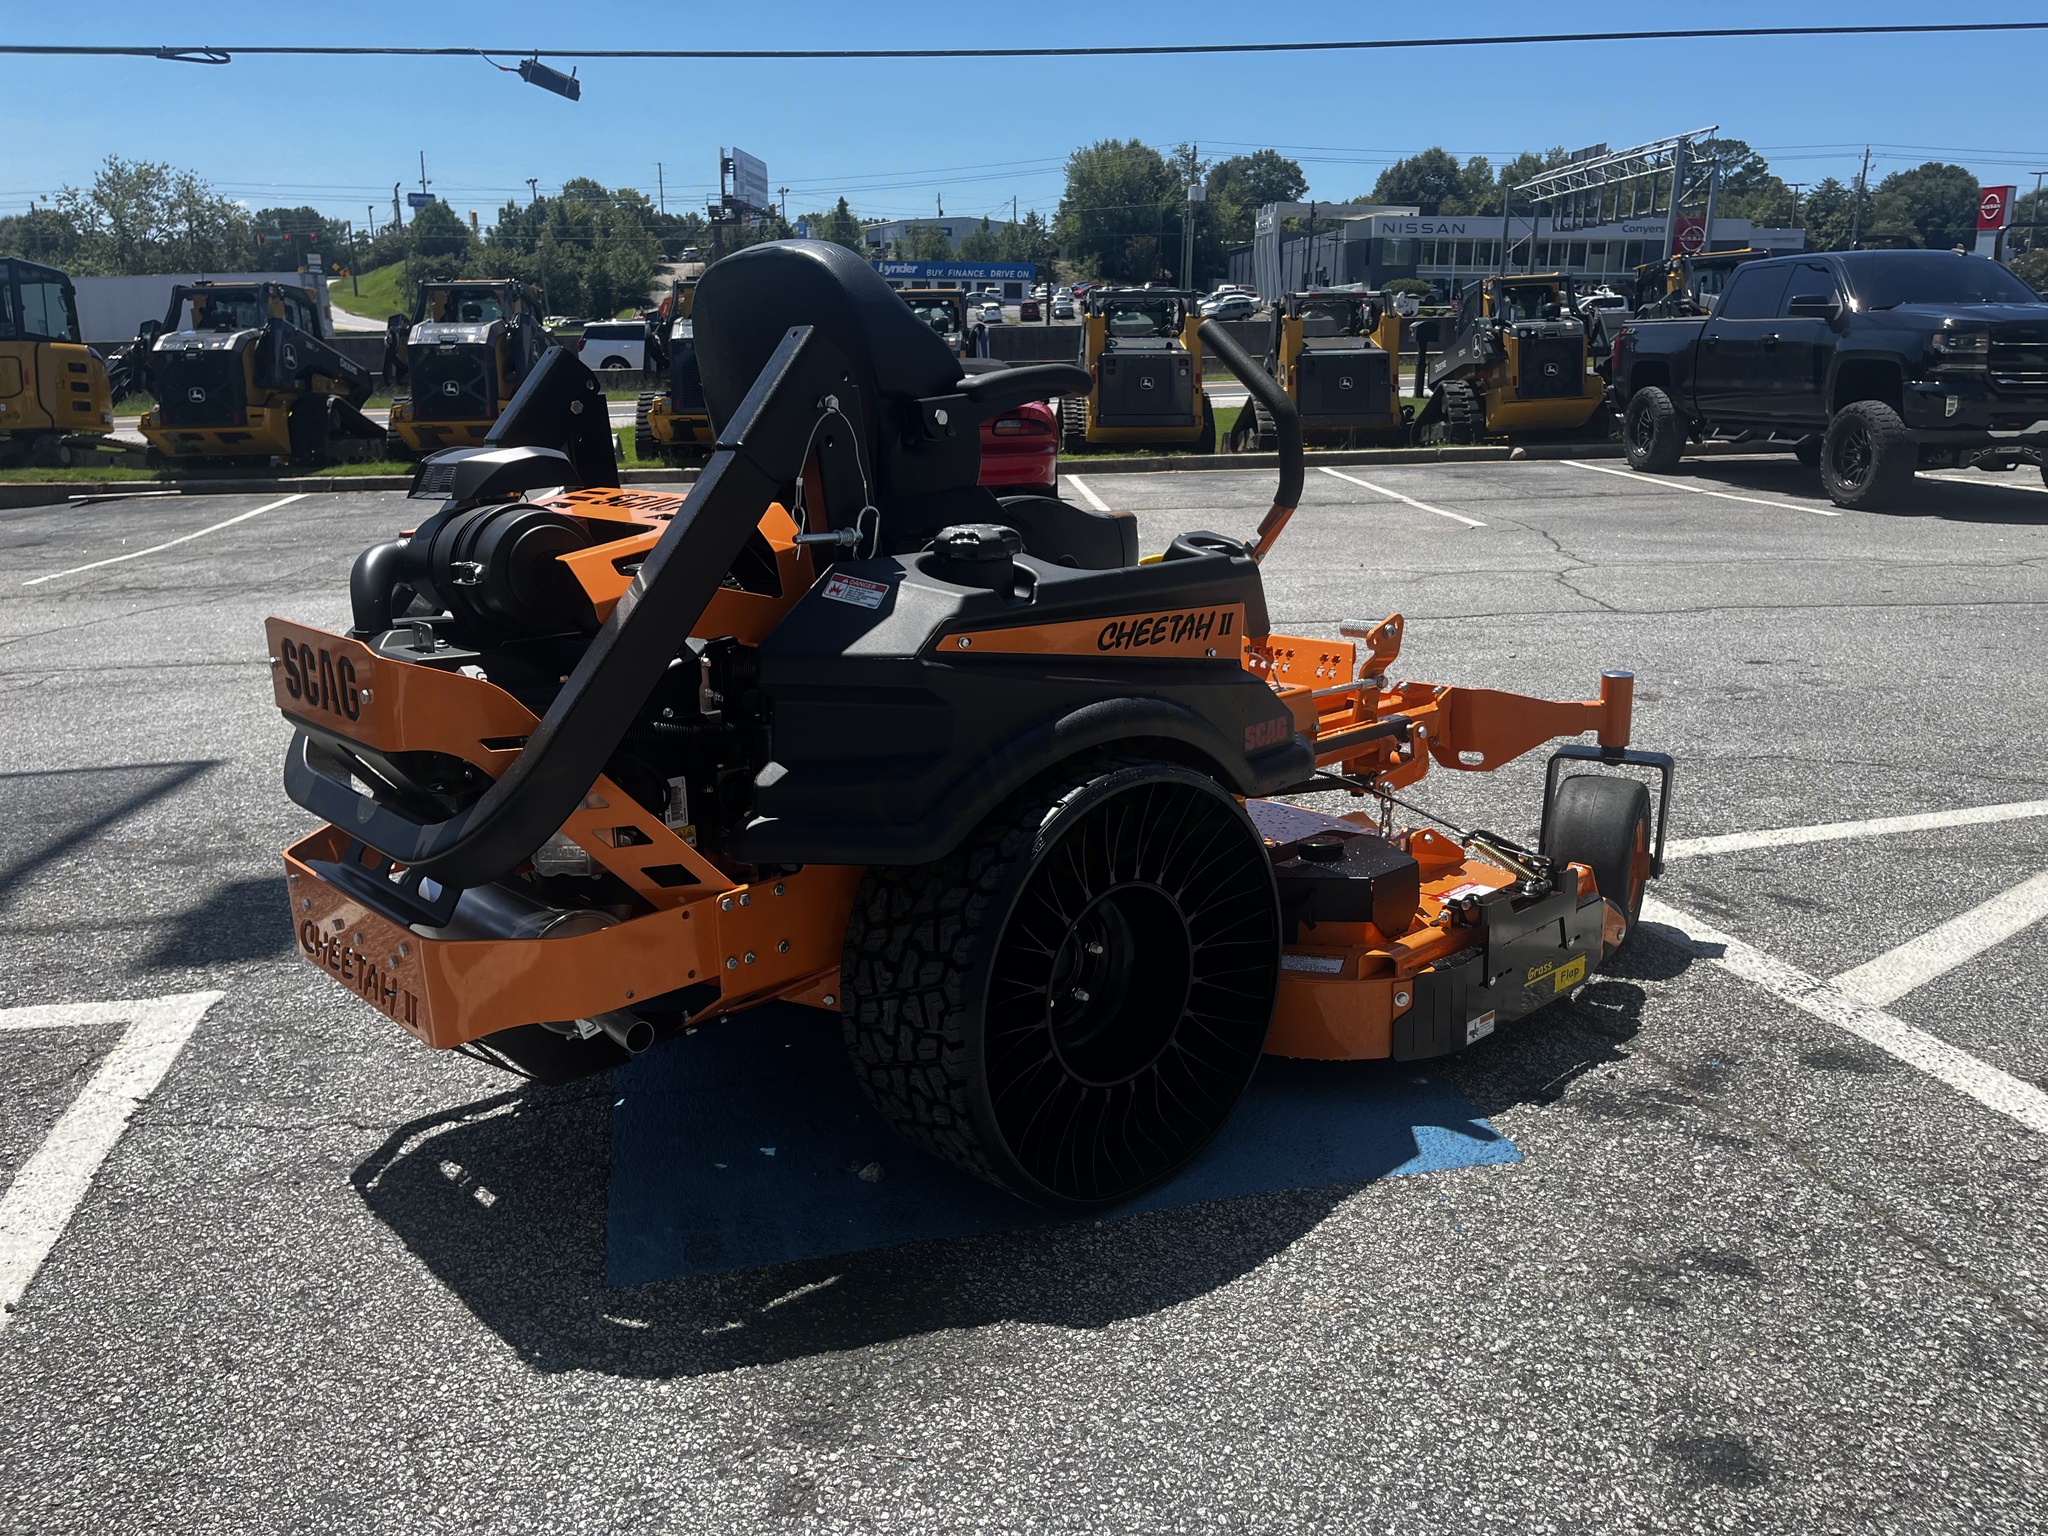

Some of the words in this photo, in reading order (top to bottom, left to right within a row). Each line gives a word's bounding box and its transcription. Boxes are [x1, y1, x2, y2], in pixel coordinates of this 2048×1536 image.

[1382, 223, 1466, 234] NISSAN
[1622, 224, 1666, 235] Conyers
[926, 269, 944, 277] BUY.
[948, 269, 986, 278] FINANCE.
[990, 270, 1015, 278] DRIVE
[1016, 270, 1031, 279] ON.
[849, 579, 877, 590] DANGER
[1097, 611, 1216, 651] CHEETAH
[1218, 612, 1235, 636] II
[281, 637, 360, 721] SCAG
[1244, 716, 1288, 751] SCAG
[300, 919, 398, 1016] CHEETAH
[404, 989, 419, 1029] II
[1527, 961, 1553, 980] Grass
[1560, 967, 1580, 983] Flap
